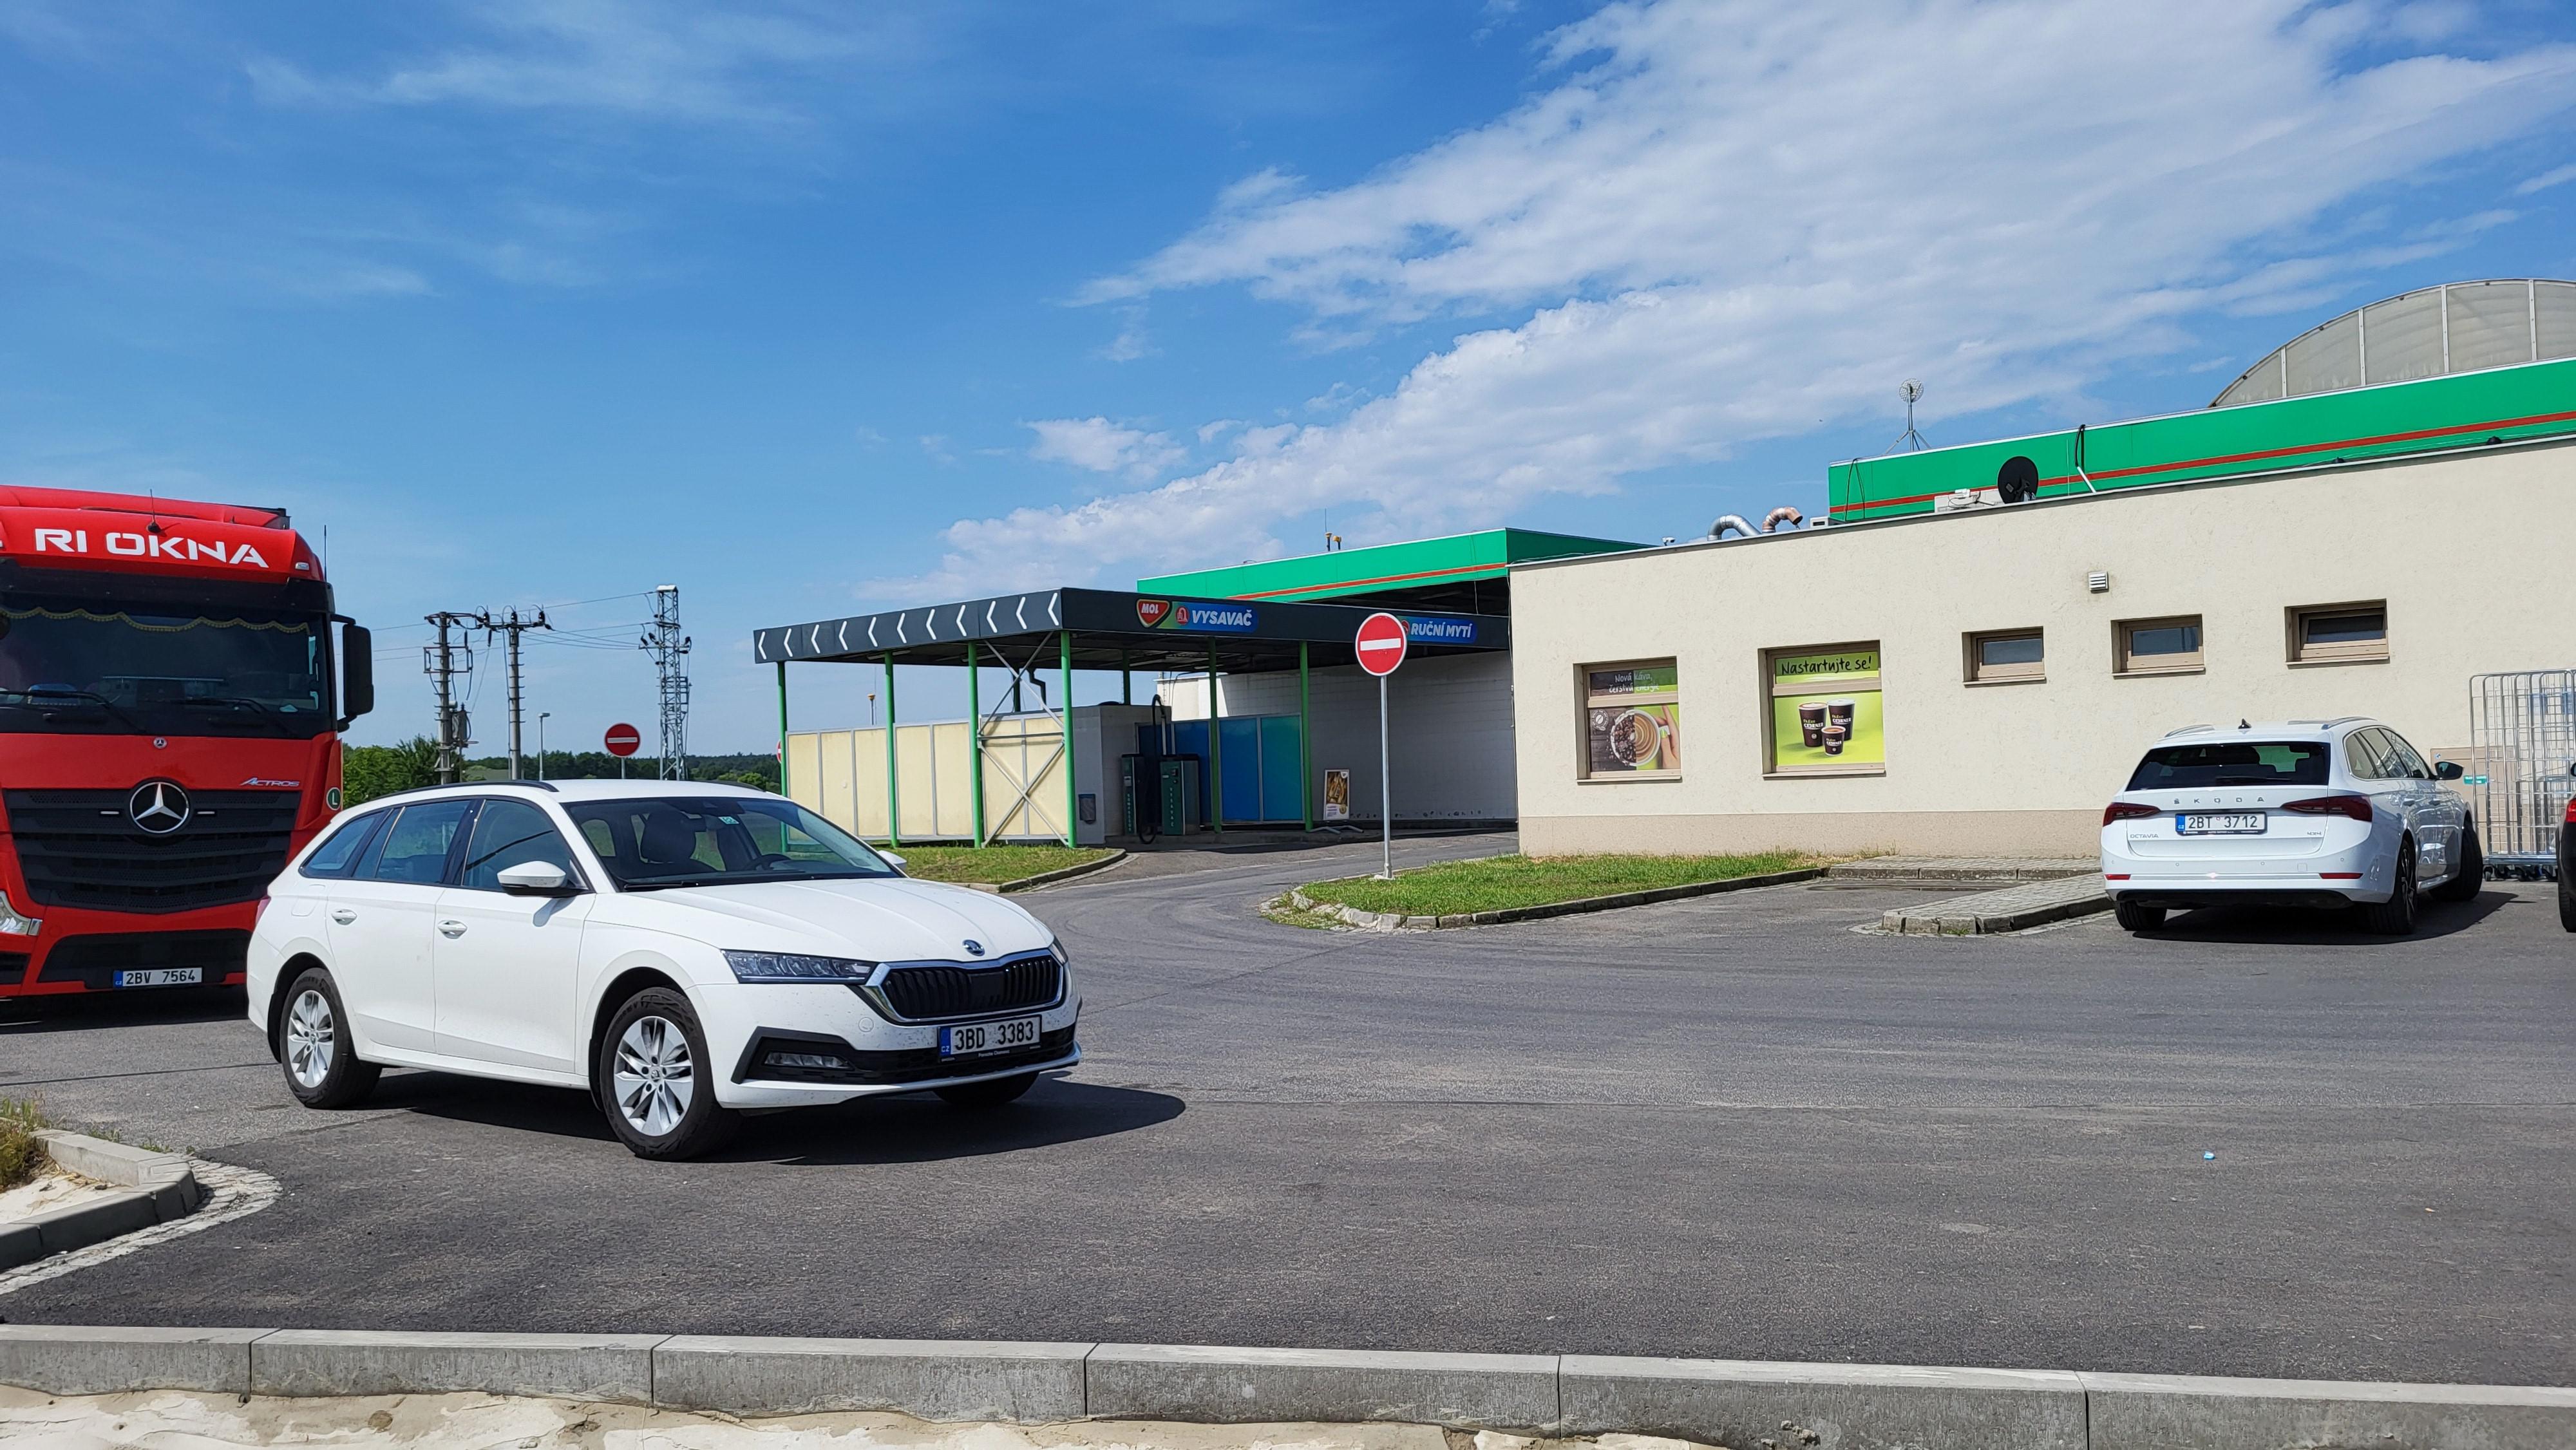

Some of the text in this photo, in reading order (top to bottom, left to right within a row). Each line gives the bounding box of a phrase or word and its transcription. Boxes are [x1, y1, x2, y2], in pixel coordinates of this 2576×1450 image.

[106, 532, 269, 569] OKNA
[1141, 603, 1159, 614] MOL
[1192, 609, 1253, 626] VYSAVAČ
[1411, 621, 1473, 638] RUČNÍ MYTÍ
[1781, 655, 1871, 675] Nastartujte se!
[1615, 672, 1632, 683] Nová
[2188, 816, 2213, 829] 2BT
[2224, 815, 2258, 829] 3712
[126, 972, 152, 984] 2BV
[162, 969, 196, 983] 7564
[954, 1027, 986, 1051] 3BD
[998, 1021, 1034, 1045] 3383
